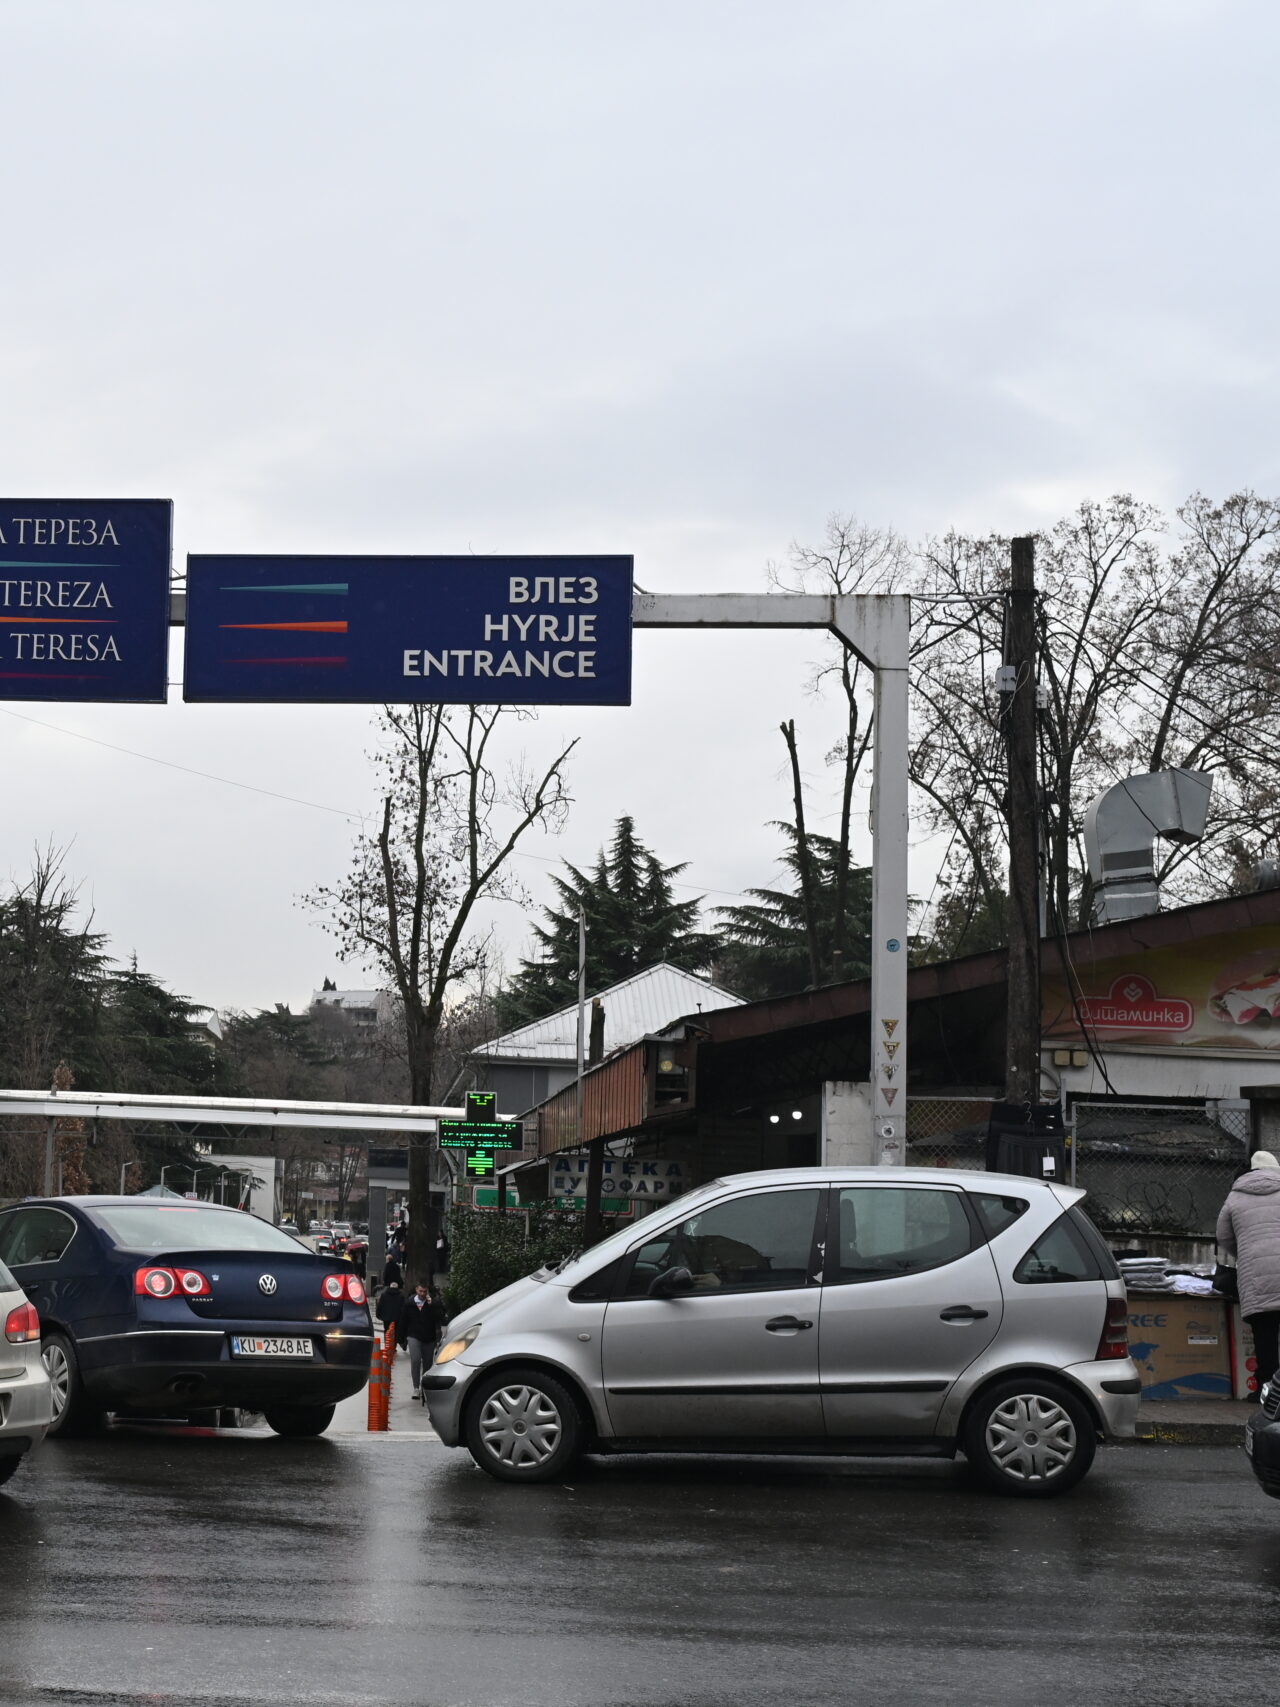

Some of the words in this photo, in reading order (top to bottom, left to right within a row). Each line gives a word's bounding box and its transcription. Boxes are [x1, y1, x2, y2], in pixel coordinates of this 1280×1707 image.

[12, 518, 120, 546] ТЕРЕЗА
[508, 576, 599, 604] ВЛЕЗ
[484, 614, 597, 642] HYRJE
[10, 633, 122, 661] TERESA
[402, 649, 596, 678] ENTRANCE
[554, 1176, 683, 1195] ЕУОФАРМ
[1126, 1314, 1169, 1328] REE
[239, 1338, 256, 1354] KU
[263, 1338, 295, 1354] 2348
[296, 1339, 312, 1355] AE
